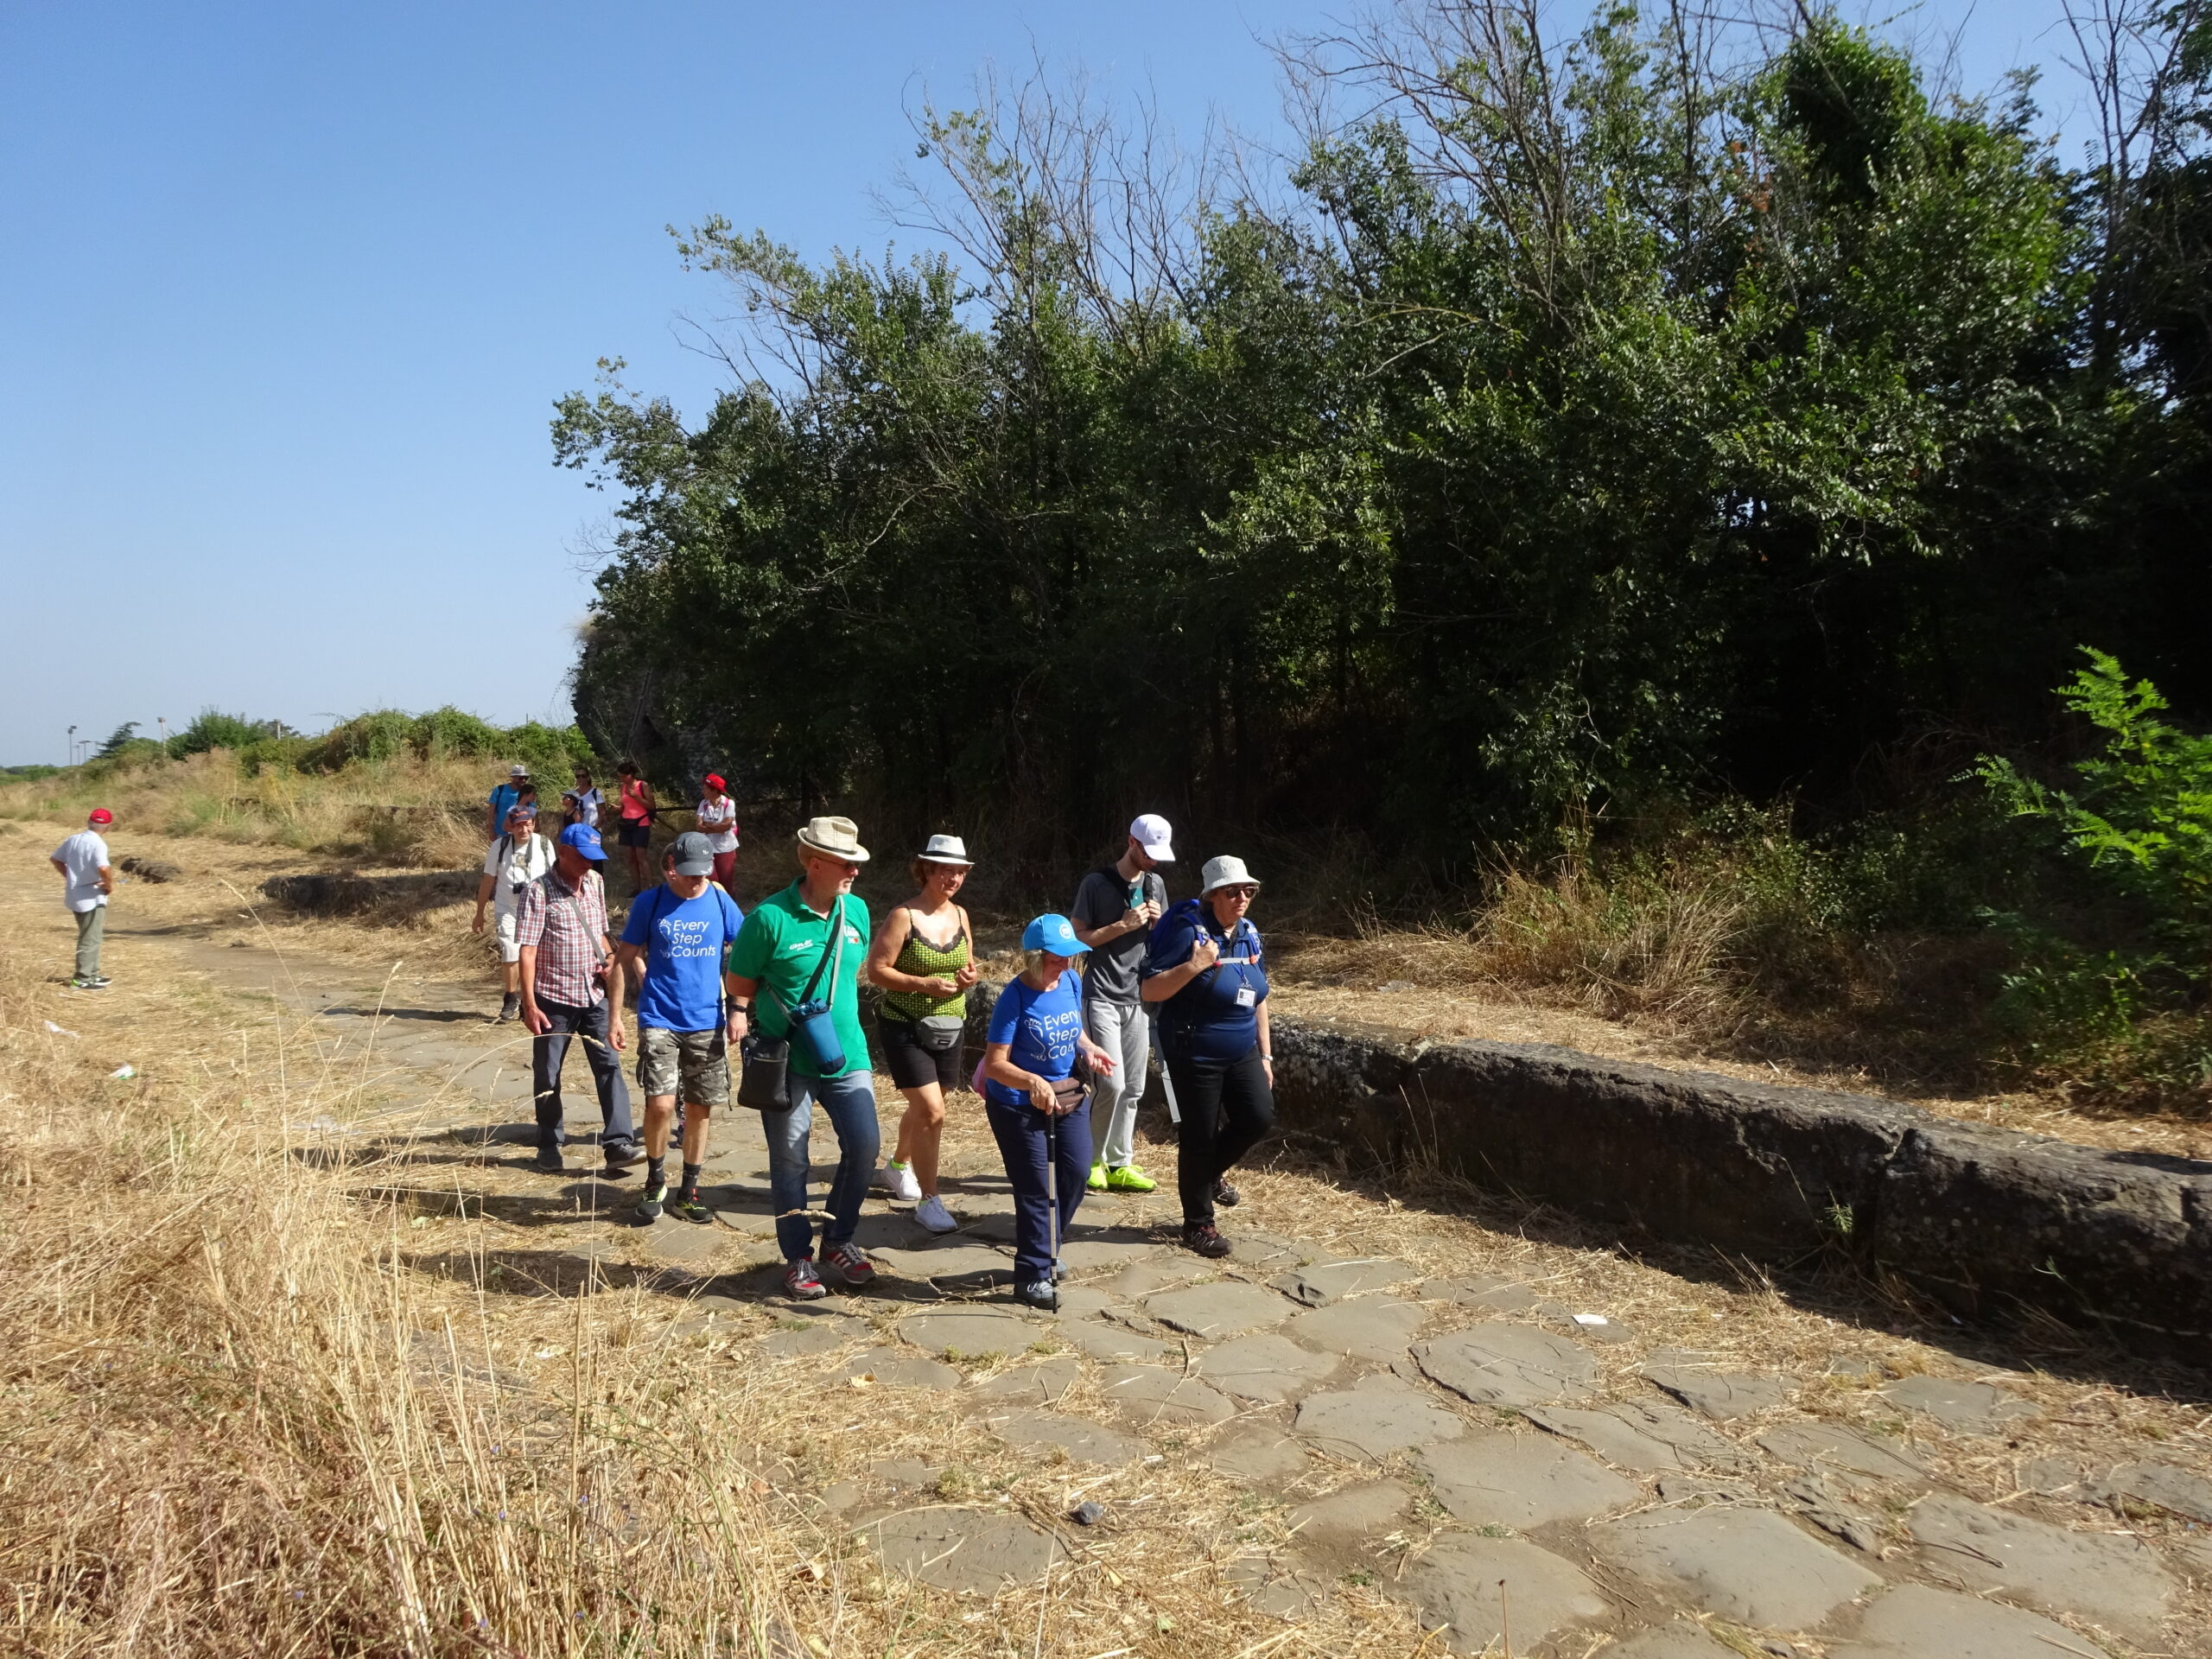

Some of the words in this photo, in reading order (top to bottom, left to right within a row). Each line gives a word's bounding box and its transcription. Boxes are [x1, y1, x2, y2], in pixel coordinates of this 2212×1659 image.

[673, 919, 709, 932] Every
[672, 932, 702, 946] Step
[671, 944, 716, 957] Counts
[1044, 1009, 1078, 1031] Every
[1048, 1027, 1079, 1046] Step
[1048, 1042, 1074, 1059] Cou
